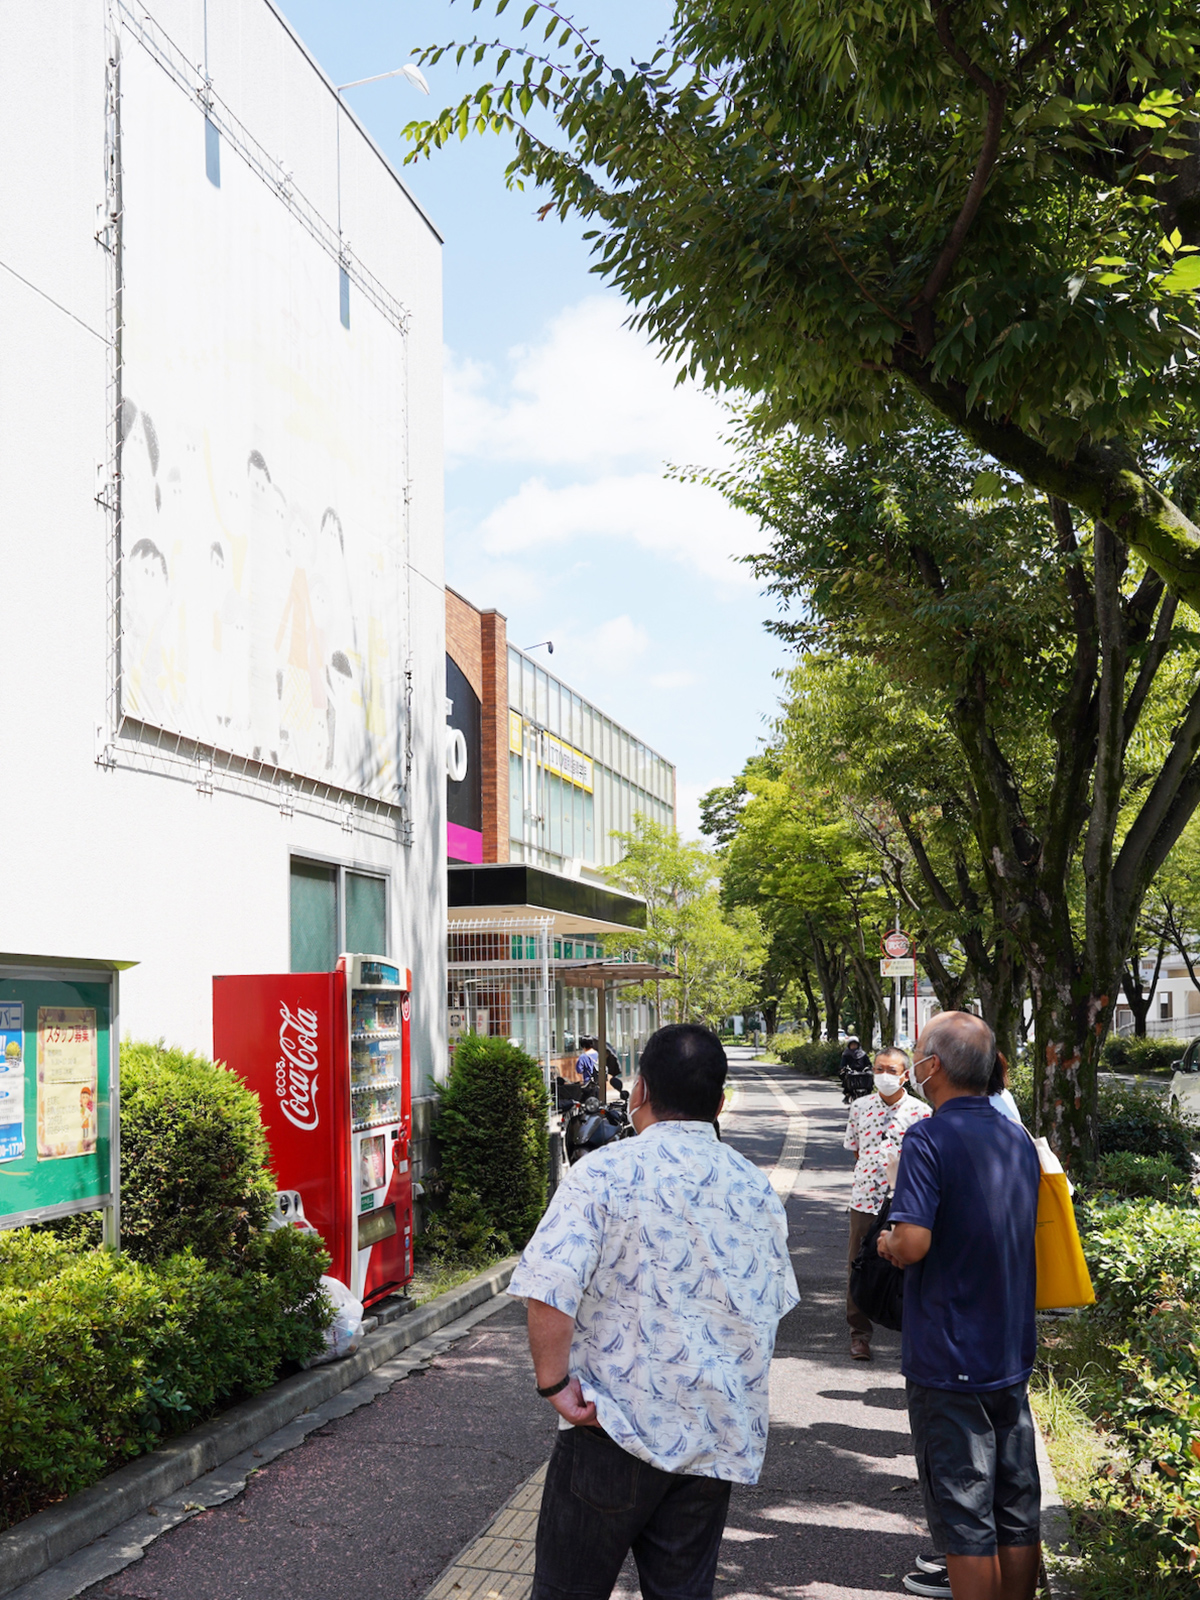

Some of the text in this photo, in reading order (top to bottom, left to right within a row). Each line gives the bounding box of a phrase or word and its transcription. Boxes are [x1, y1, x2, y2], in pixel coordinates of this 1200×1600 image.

[46, 1024, 89, 1043] スタッフ募集
[278, 1000, 319, 1131] Coca-Cola
